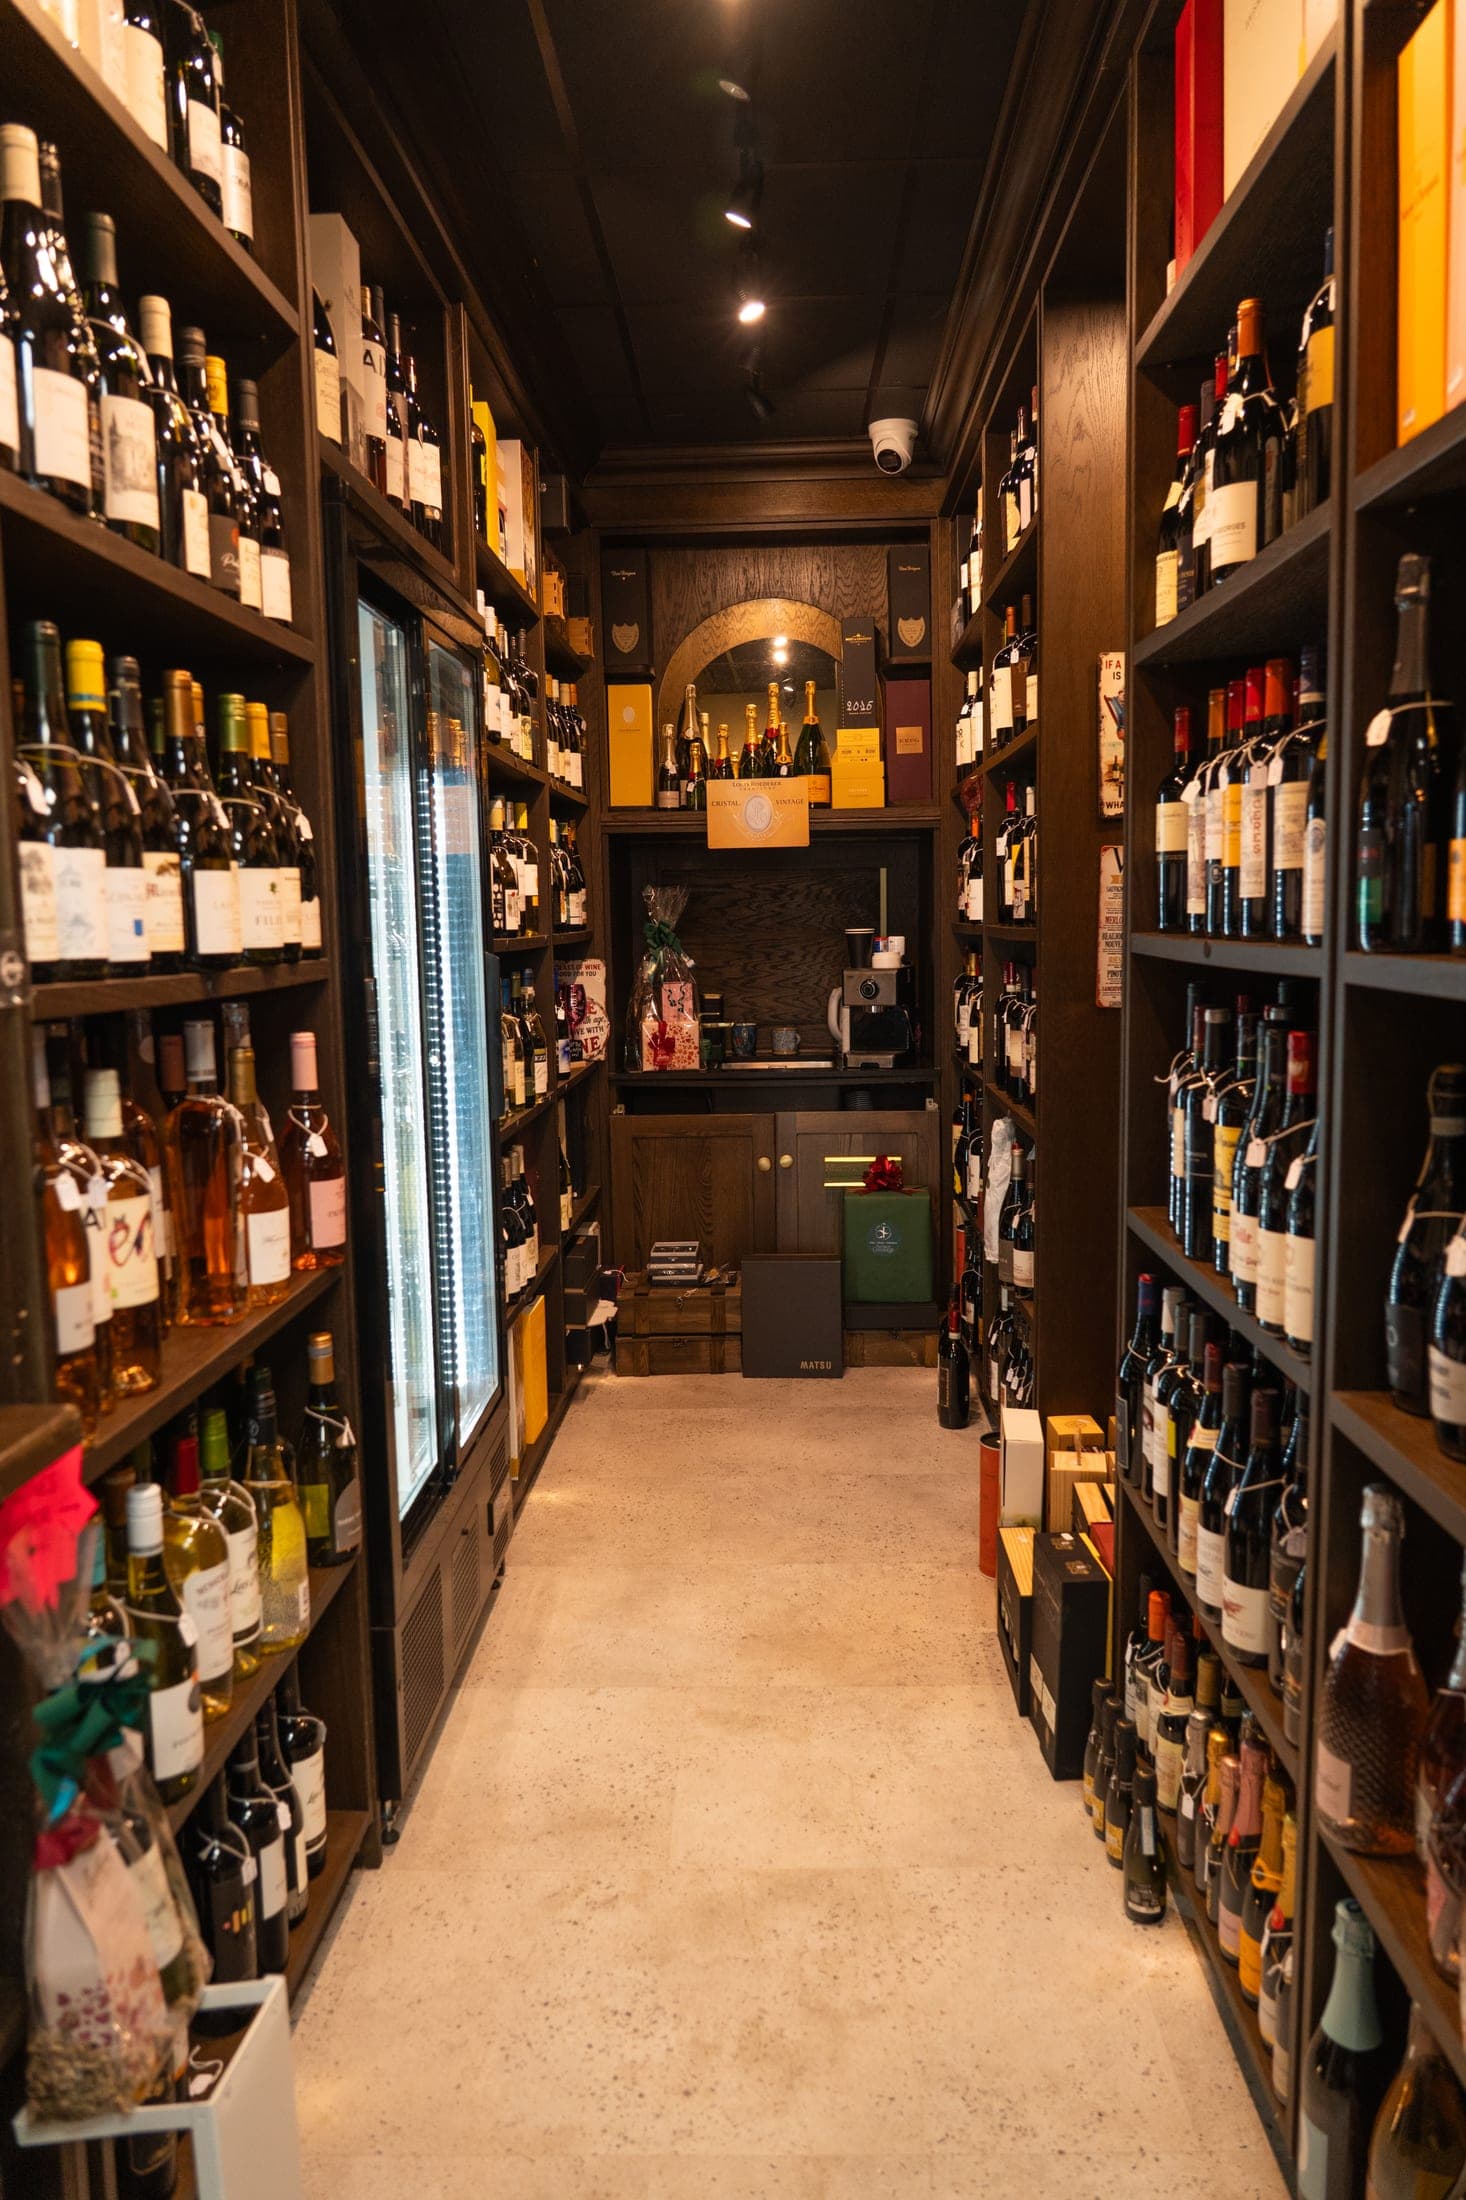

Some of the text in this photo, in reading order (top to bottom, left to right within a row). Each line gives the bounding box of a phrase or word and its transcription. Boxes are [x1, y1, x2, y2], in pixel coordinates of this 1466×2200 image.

[1105, 660, 1121, 670] IF A
[1112, 671, 1121, 680] IS
[775, 798, 804, 806] VINTAGE
[585, 963, 601, 971] WINE
[586, 1026, 604, 1035] WITH
[800, 1360, 832, 1370] MATSU
